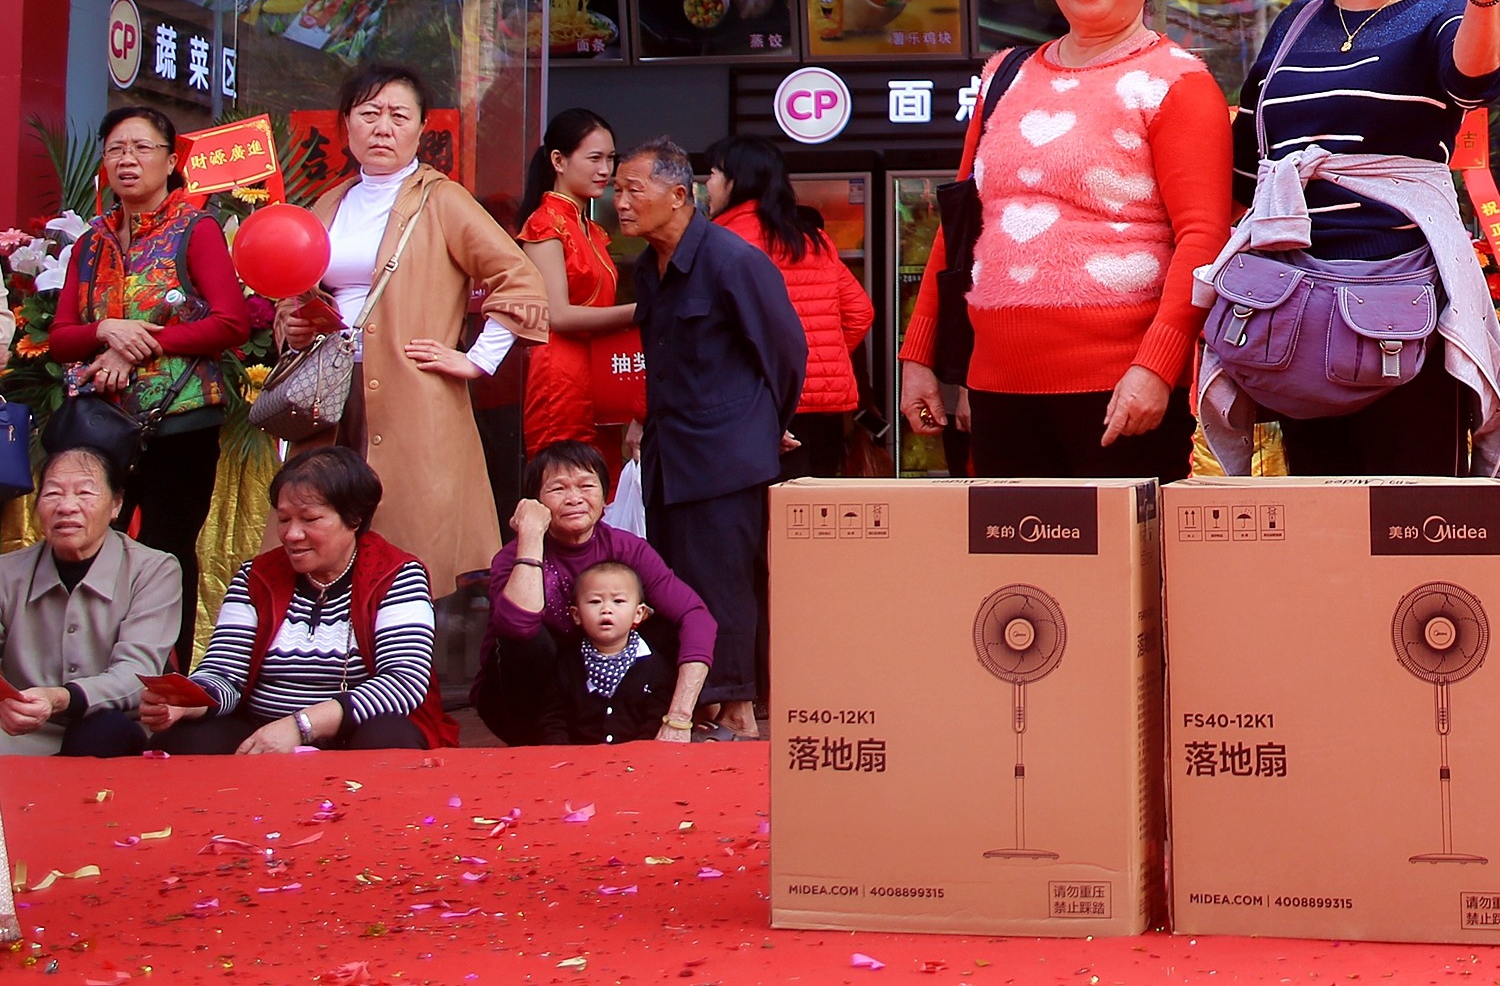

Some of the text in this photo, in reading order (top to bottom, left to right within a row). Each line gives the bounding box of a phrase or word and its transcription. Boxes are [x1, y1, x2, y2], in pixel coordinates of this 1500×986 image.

[110, 20, 137, 61] CP
[154, 22, 238, 99] 蔬菜区
[784, 89, 840, 121] CP
[986, 515, 1080, 543] 美的 Midea
[1389, 515, 1487, 543] 美的 Midea
[787, 709, 875, 725] FS40-12K1
[1183, 713, 1274, 729] FS40-12K1
[787, 735, 887, 773] 落地扇
[1184, 740, 1287, 778] 落地扇
[788, 884, 945, 899] MIDEA.COM 4008899315
[1053, 884, 1106, 899] 请勿重压
[1189, 892, 1353, 910] MIDEA.COM 4008899315
[1053, 900, 1106, 916] 禁止踩踏
